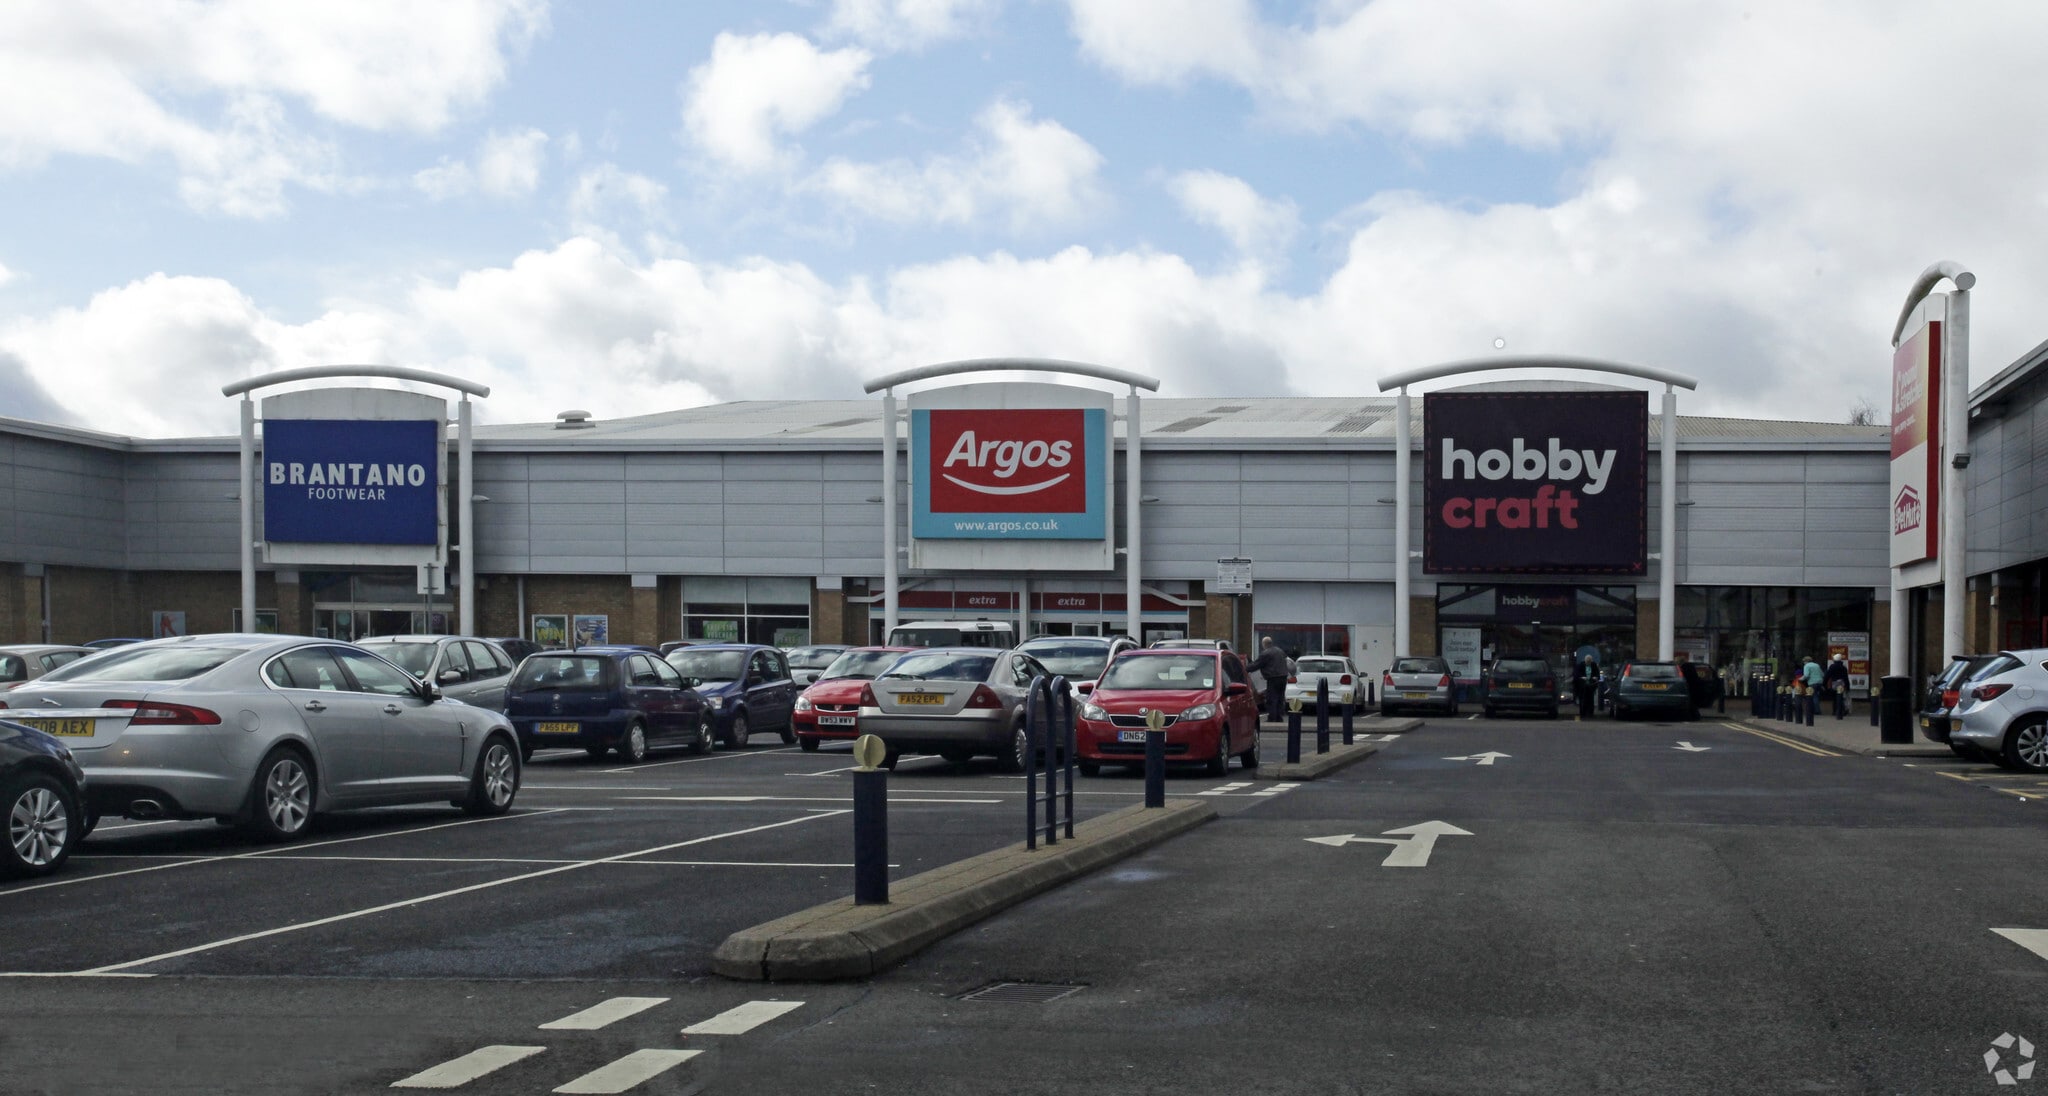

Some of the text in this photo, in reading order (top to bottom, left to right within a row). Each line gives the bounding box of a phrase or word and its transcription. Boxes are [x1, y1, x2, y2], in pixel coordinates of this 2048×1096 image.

[943, 430, 1072, 478] Argos
[1442, 437, 1617, 495] hobby
[270, 462, 426, 487] BRANTANO
[308, 487, 386, 501] FOOTWEAR
[1442, 484, 1579, 529] craft
[954, 519, 1059, 533] www.argos.co.uk
[969, 595, 996, 605] extra
[1057, 597, 1085, 606] extra
[536, 627, 564, 641] WIN
[900, 694, 940, 704] FA52 EPL
[61, 721, 88, 734] AEX
[1123, 731, 1146, 740] DN62
